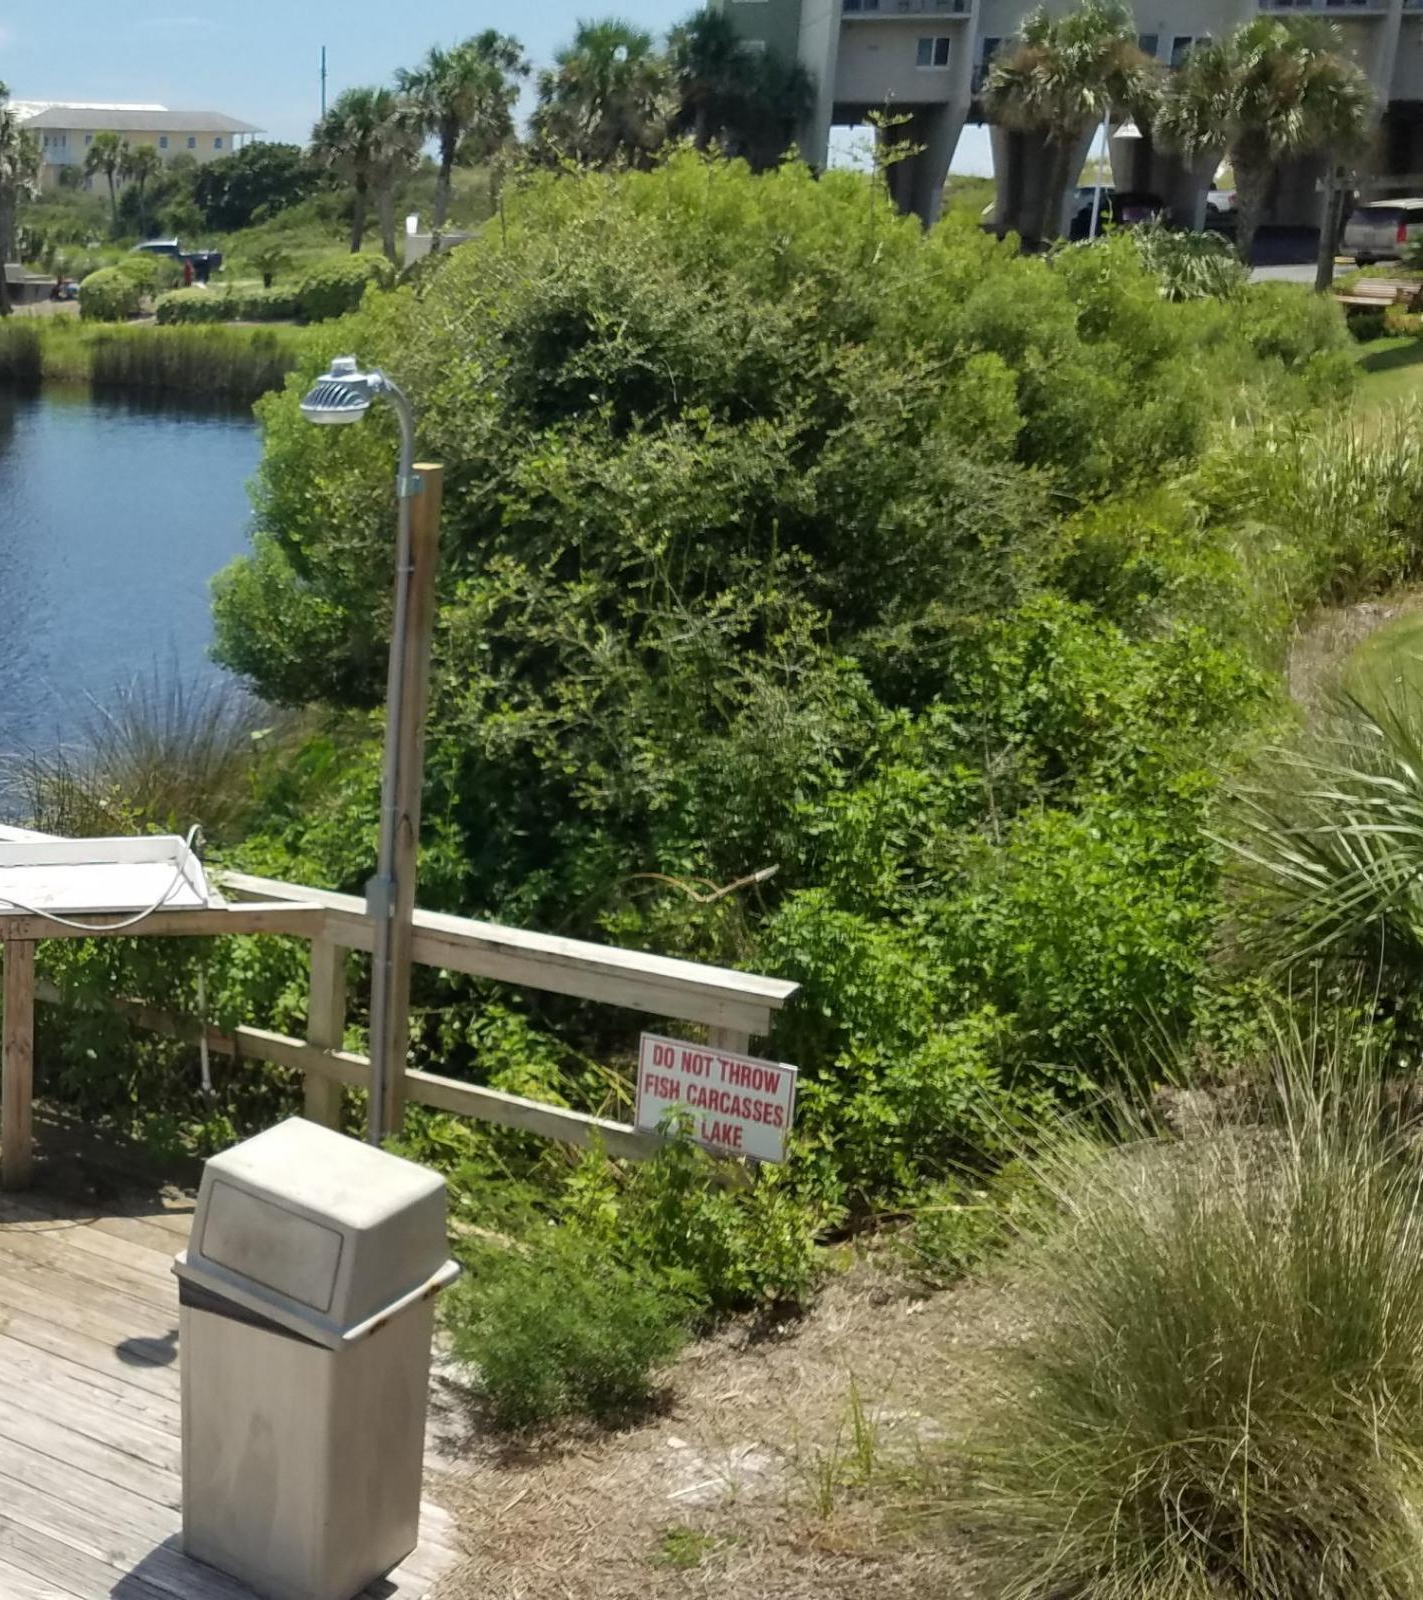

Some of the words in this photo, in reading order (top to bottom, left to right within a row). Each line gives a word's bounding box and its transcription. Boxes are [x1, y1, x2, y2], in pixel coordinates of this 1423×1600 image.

[653, 1045, 675, 1069] DO
[681, 1051, 713, 1078] NOT
[717, 1058, 781, 1095] THROW
[644, 1074, 680, 1100] FISH
[686, 1084, 784, 1129] CARCASSES
[701, 1119, 743, 1148] LAKE
